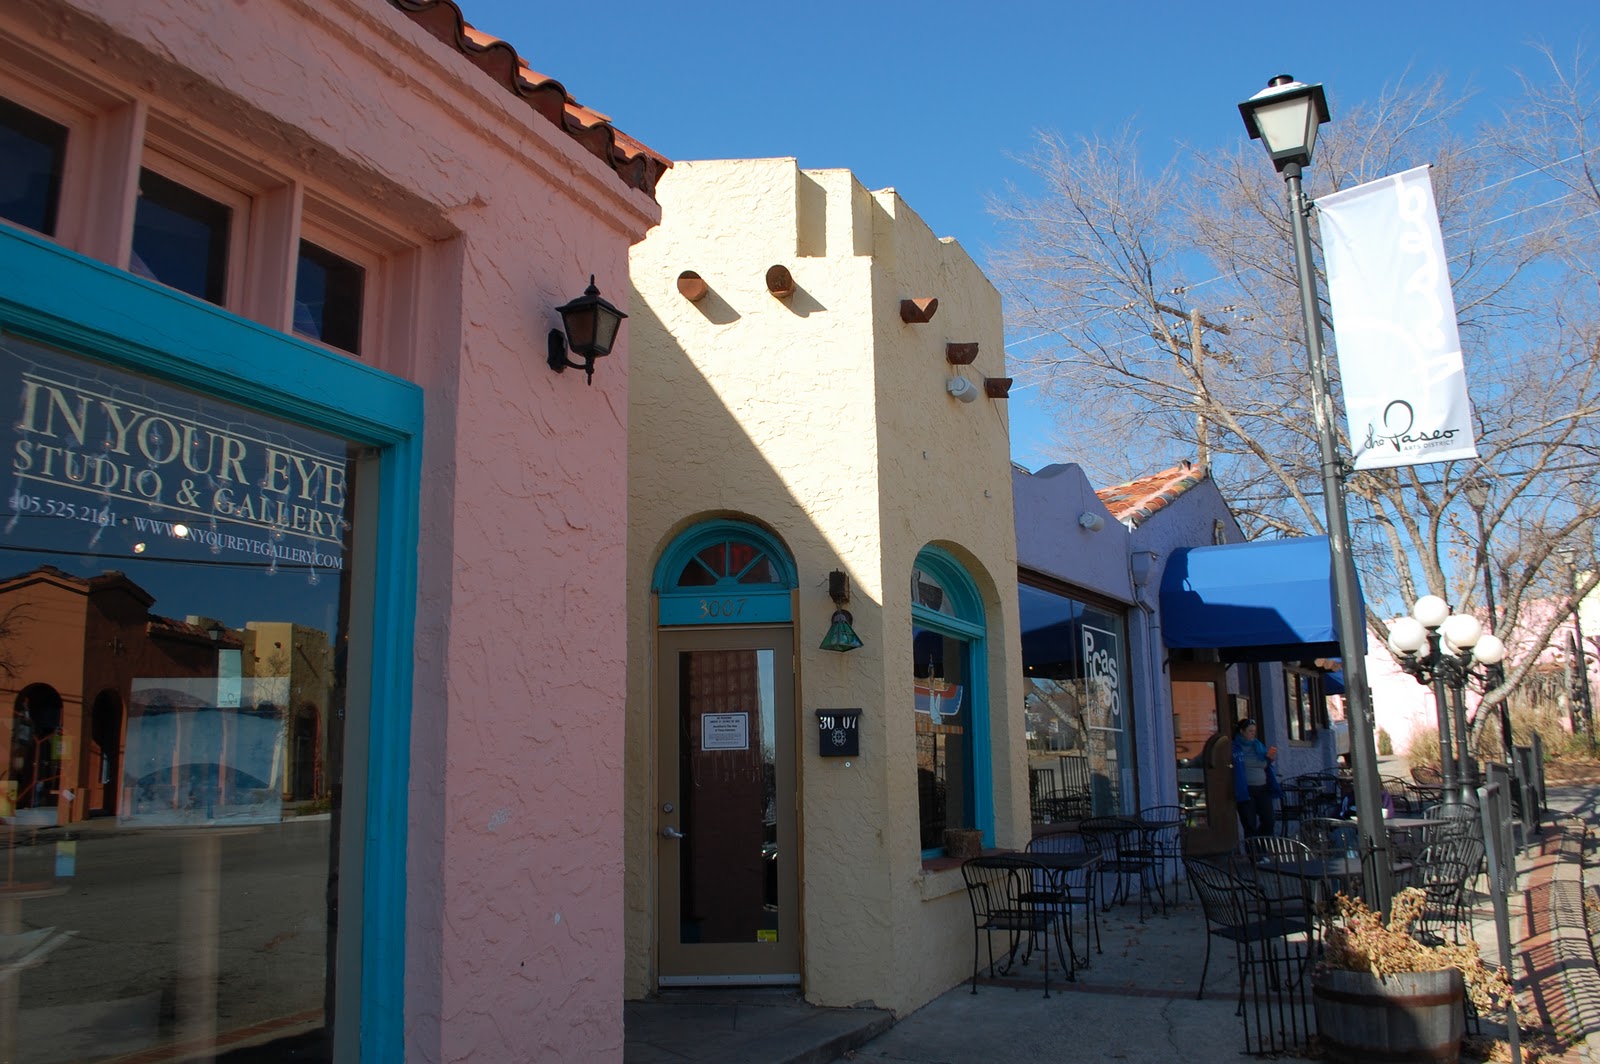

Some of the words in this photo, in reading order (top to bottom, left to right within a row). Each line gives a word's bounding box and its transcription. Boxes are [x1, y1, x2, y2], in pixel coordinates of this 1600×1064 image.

[20, 379, 94, 447] IN
[101, 401, 250, 486] YOUR
[262, 447, 346, 509] EYE
[1377, 399, 1460, 453] Paseo
[1423, 439, 1455, 449] DISTRICT
[13, 439, 163, 498] STUDIO
[176, 478, 201, 509] &
[214, 487, 345, 539] GALLERY
[133, 516, 344, 570] WWW.NYOUREYEGALLERY.COM
[699, 598, 747, 619] 3007
